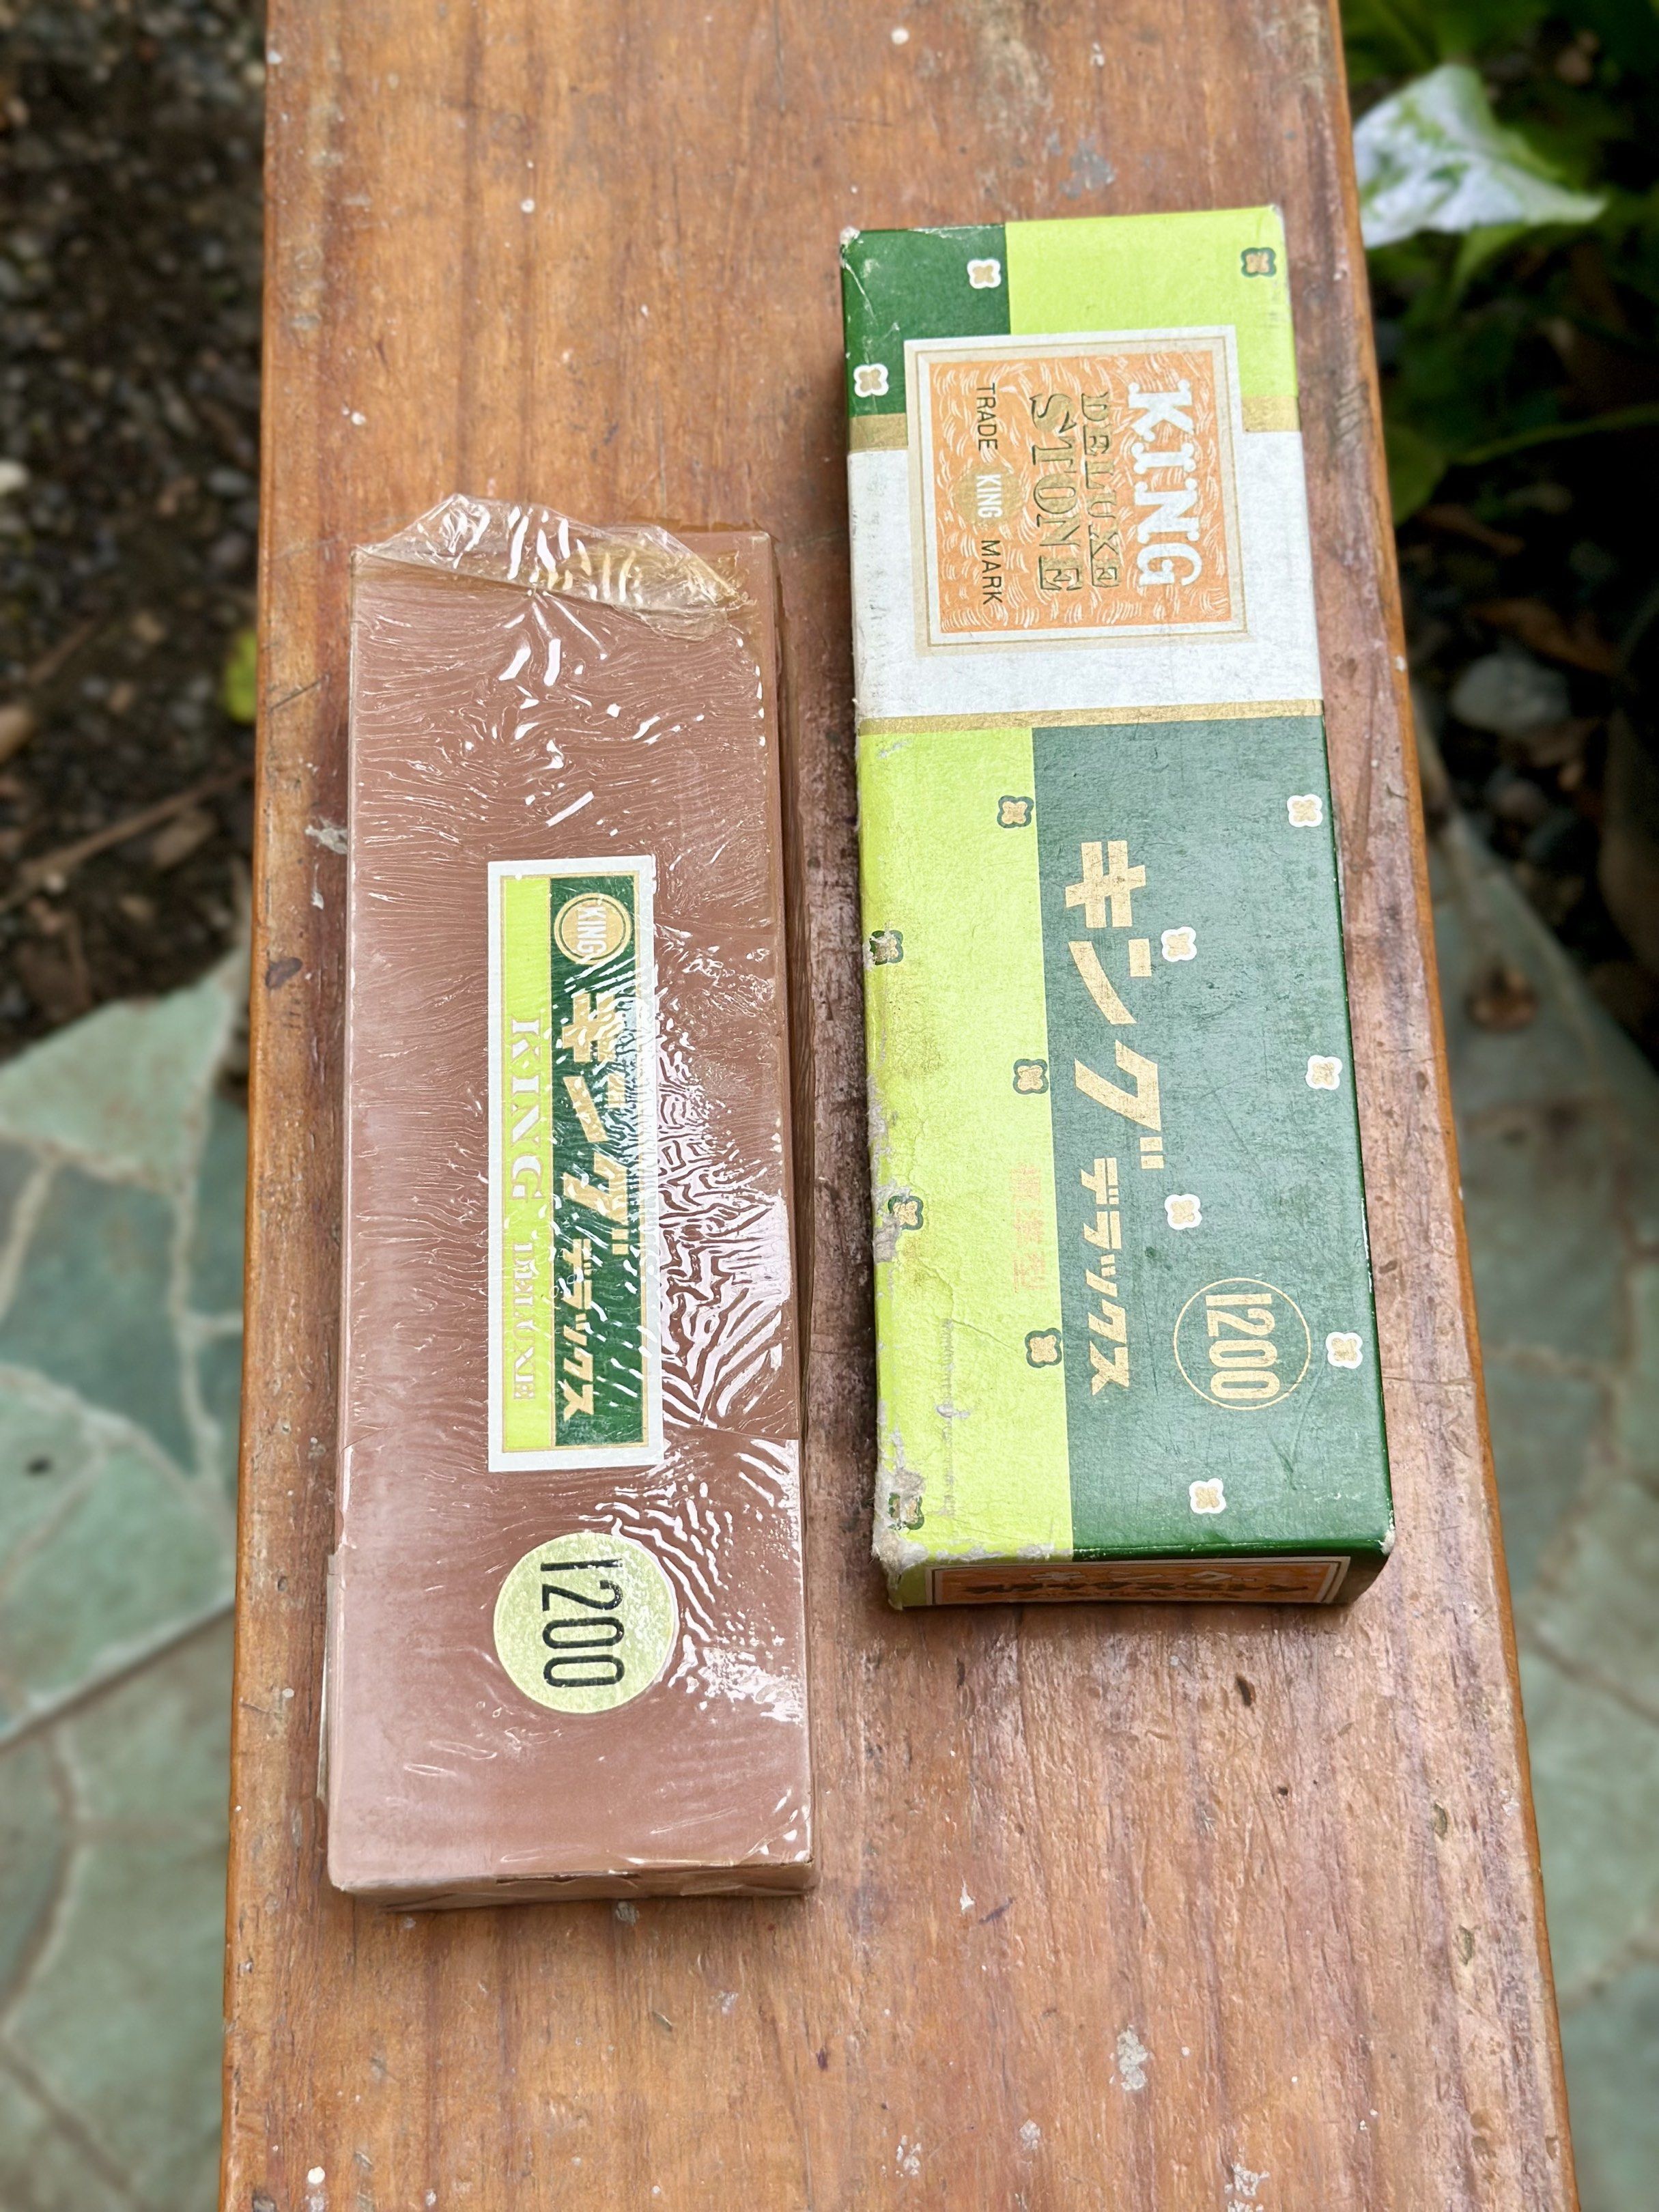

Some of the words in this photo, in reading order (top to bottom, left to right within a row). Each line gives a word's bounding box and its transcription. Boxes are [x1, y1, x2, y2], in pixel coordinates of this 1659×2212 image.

[976, 382, 999, 451] TRADE
[975, 472, 1004, 520] KING
[1029, 392, 1084, 593] STONE
[1081, 391, 1122, 589] DELUXE
[1127, 378, 1204, 588] KING
[980, 539, 1004, 606] MARK
[575, 905, 606, 955] KING
[509, 1017, 543, 1203] KING
[511, 1241, 538, 1402] DELUXE
[1204, 1291, 1282, 1400] 1200
[540, 1558, 625, 1688] 1200
